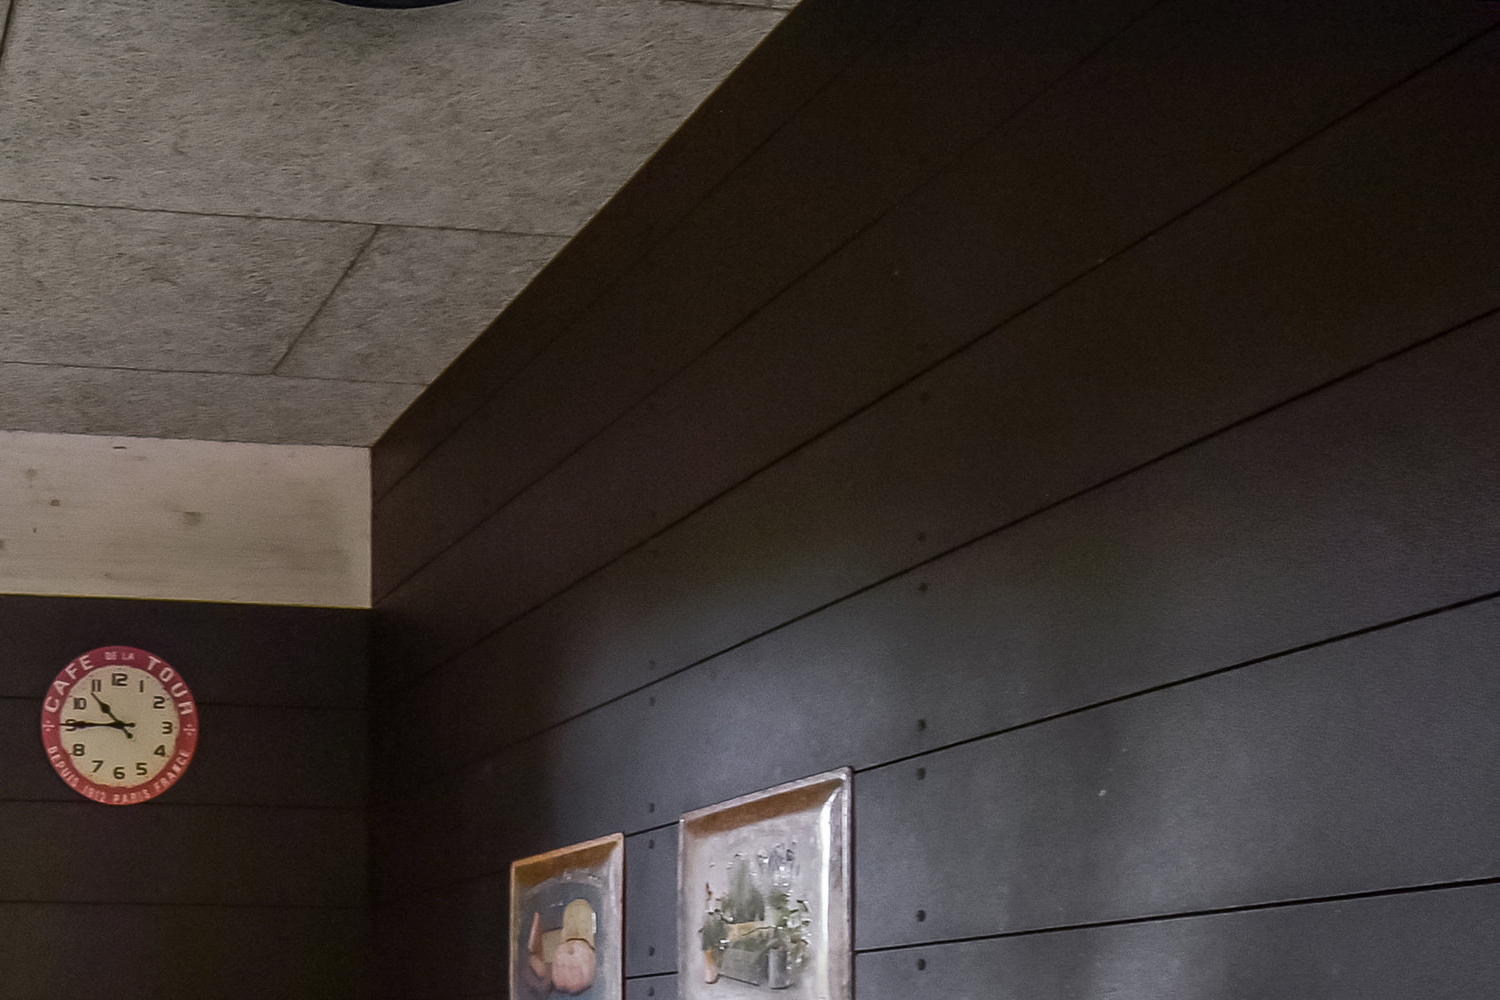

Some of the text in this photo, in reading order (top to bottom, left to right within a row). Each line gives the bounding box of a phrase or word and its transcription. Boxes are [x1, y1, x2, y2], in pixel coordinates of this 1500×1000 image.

[91, 679, 102, 693] 11
[111, 672, 128, 687] 12
[139, 679, 145, 693] 1
[147, 655, 194, 715] TOUR
[73, 697, 87, 711] 10
[153, 695, 166, 710] 2
[161, 720, 174, 735] 3
[73, 743, 86, 757] 8
[153, 744, 166, 758] 4
[91, 760, 104, 773] 7
[113, 766, 126, 780] 6
[135, 762, 148, 776] 5
[114, 789, 151, 803] PARIS
[154, 749, 190, 793] FRANCE
